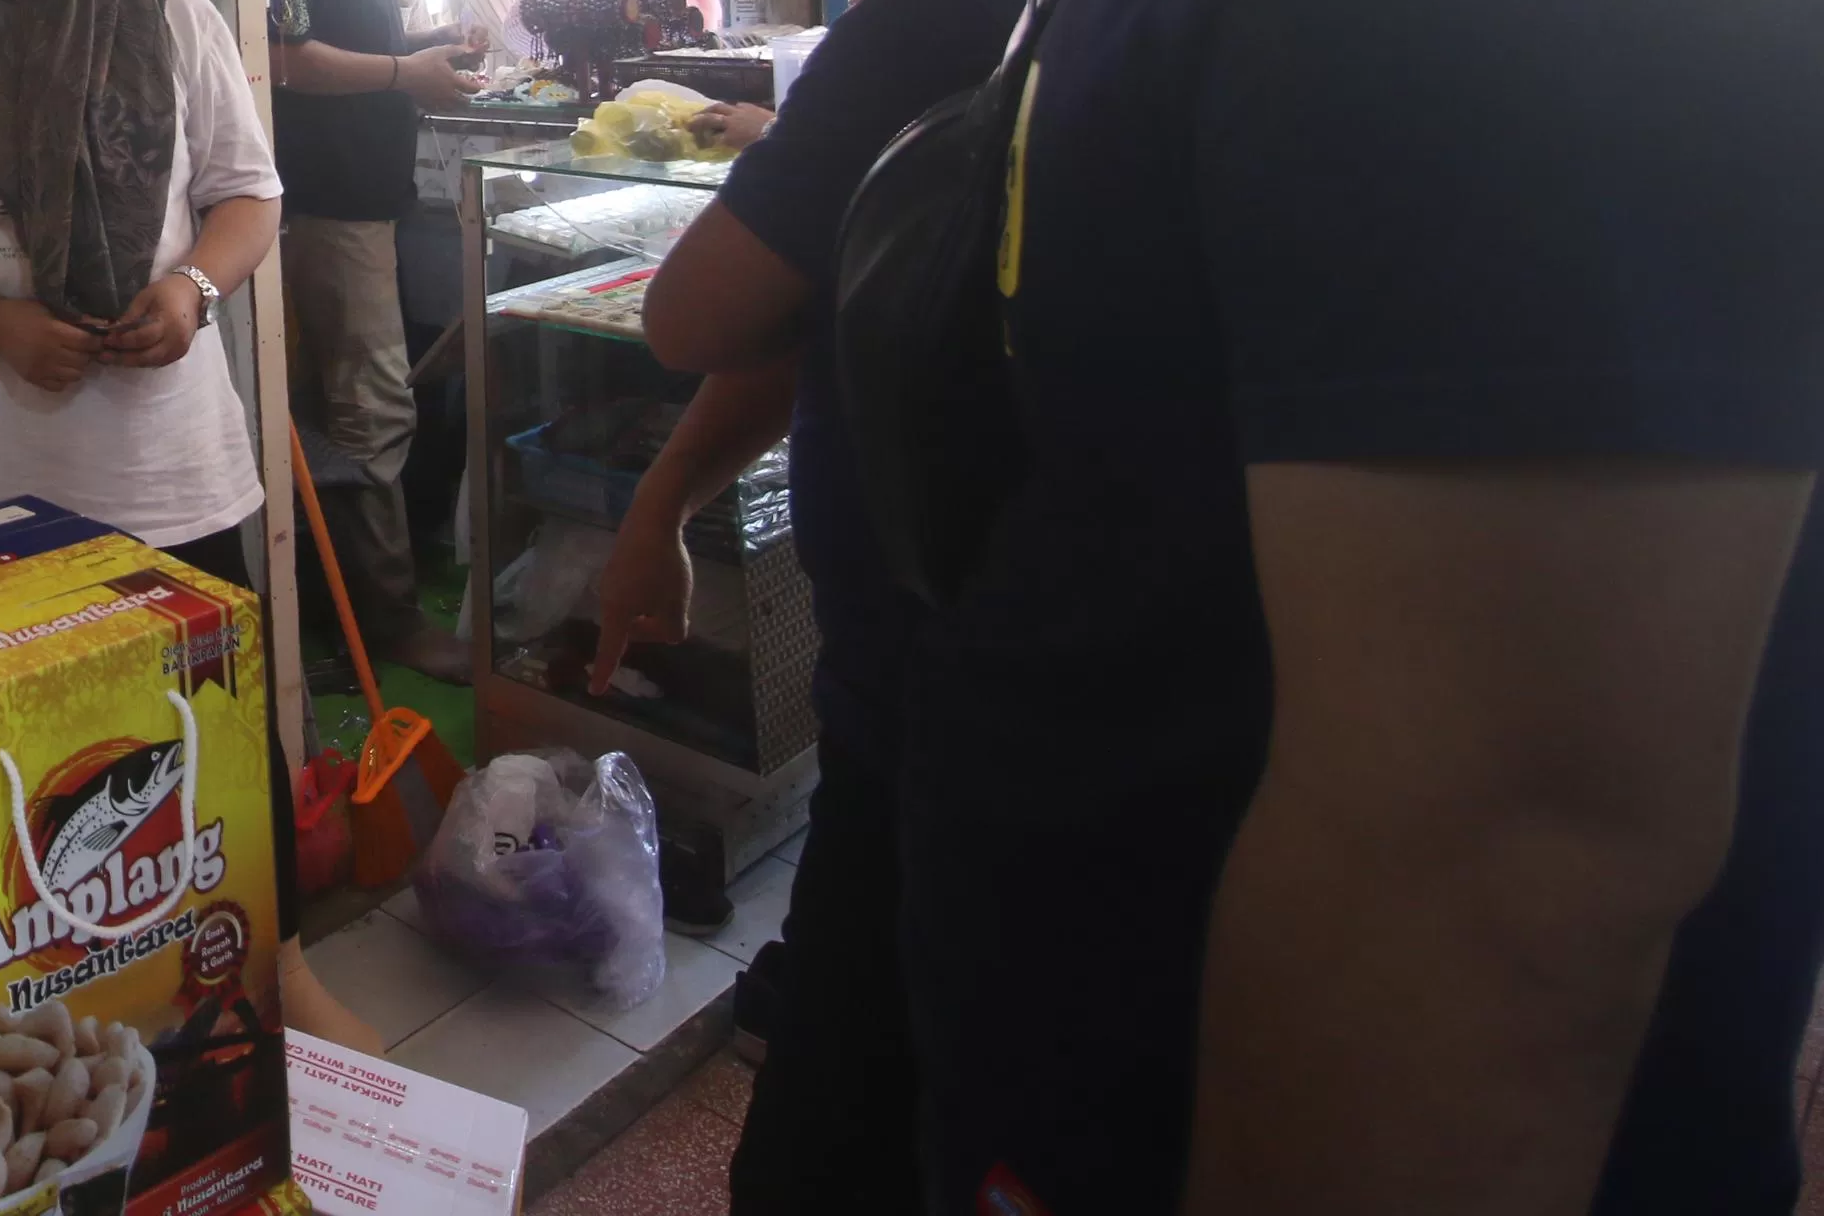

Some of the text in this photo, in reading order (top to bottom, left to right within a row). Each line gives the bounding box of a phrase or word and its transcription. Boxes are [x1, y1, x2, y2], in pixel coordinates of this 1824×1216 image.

[162, 636, 241, 676] BALIKPAPAN
[204, 923, 226, 941] Enak
[201, 935, 232, 959] Renyah
[210, 949, 234, 969] Gurih
[7, 907, 196, 1016] Nusantara
[307, 1051, 344, 1070] WITH
[303, 1067, 404, 1108] ANGKAT HATI
[348, 1064, 407, 1093] HANDLE
[296, 1152, 384, 1193] HATI HATI
[333, 1189, 378, 1211] CARE
